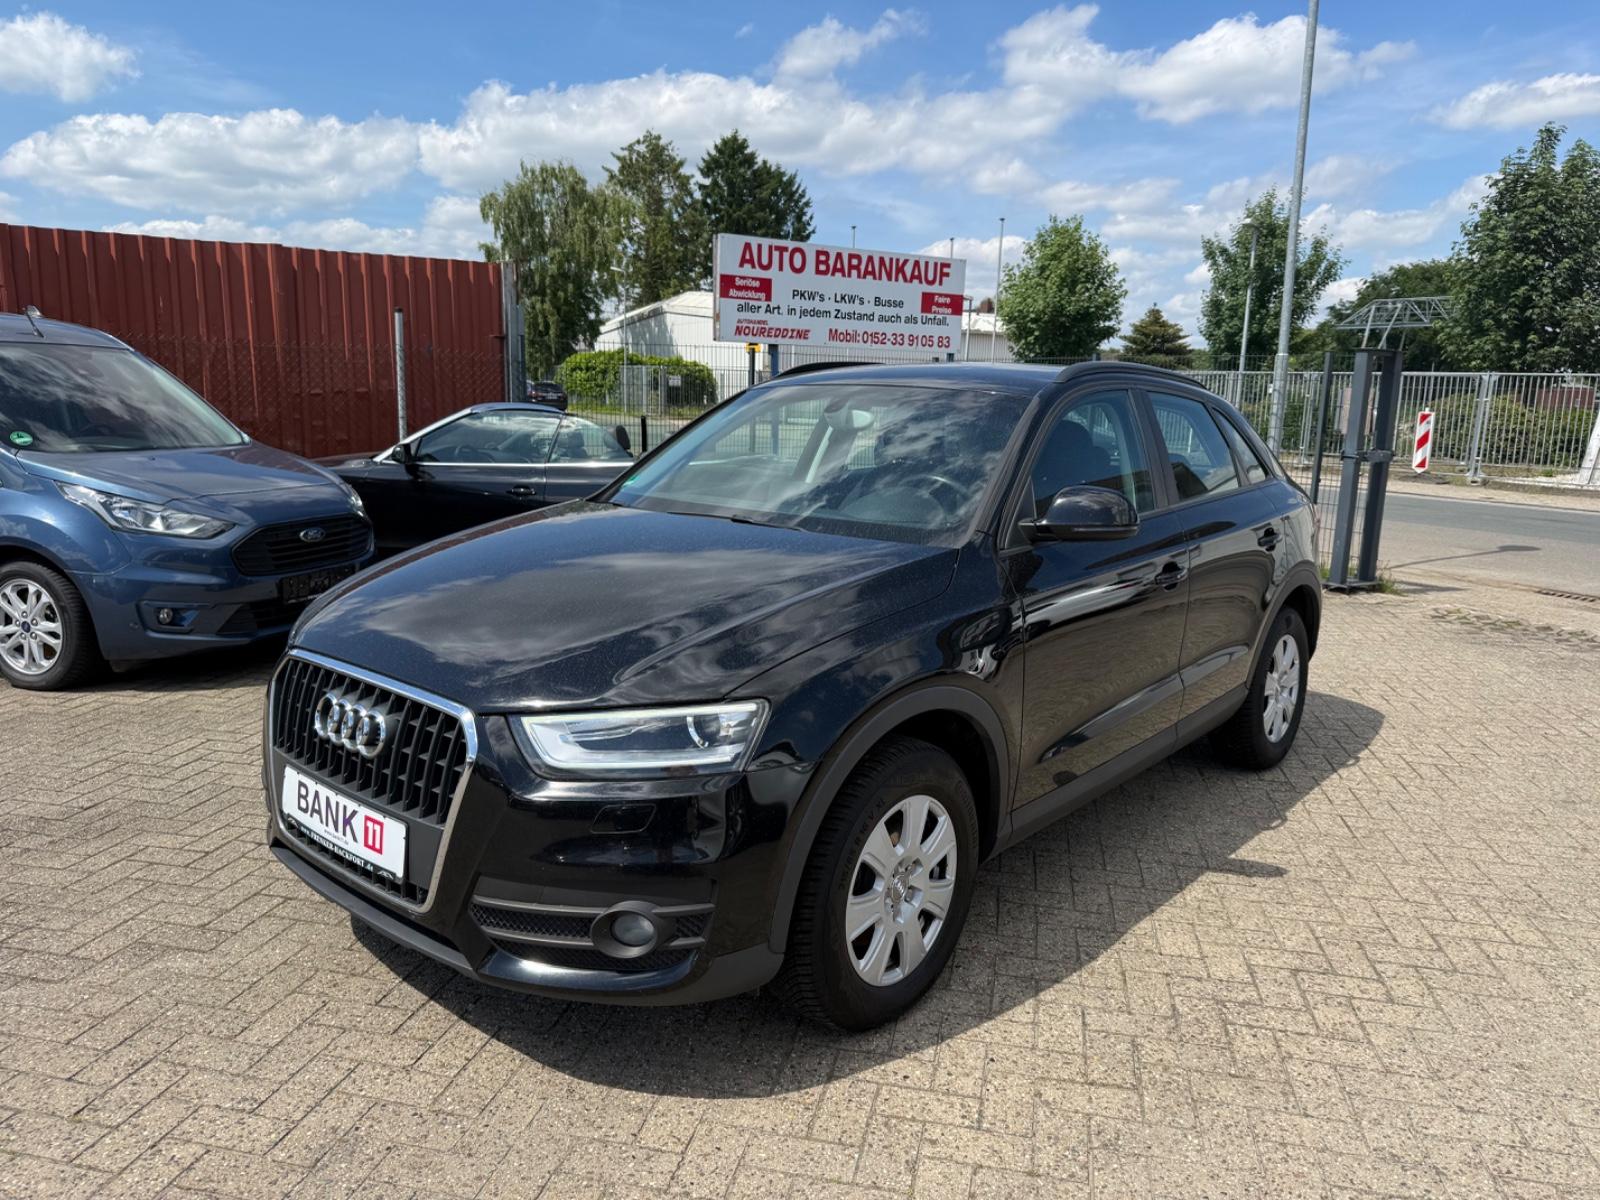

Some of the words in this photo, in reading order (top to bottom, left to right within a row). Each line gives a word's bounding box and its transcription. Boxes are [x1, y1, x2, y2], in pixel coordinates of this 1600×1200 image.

[738, 242, 806, 274] AUTO
[815, 250, 952, 286] BARANKAUF
[735, 278, 760, 287] Seriöse
[729, 289, 765, 300] Abwicklung
[792, 289, 825, 302] PKW's
[834, 292, 864, 305] LKW's
[874, 297, 904, 308] Busse
[737, 302, 762, 313] aller
[787, 305, 796, 315] in
[799, 306, 831, 319] jedem
[834, 309, 874, 322] Zustand
[878, 314, 901, 323] auch
[904, 315, 918, 325] als
[921, 315, 949, 326] Unfall.
[735, 326, 810, 340] NOUREDDINE
[828, 328, 860, 343] Mobil:
[862, 331, 905, 346] 0152-33
[937, 336, 950, 348] 83
[297, 780, 359, 843] BANK
[366, 819, 381, 849] 11
